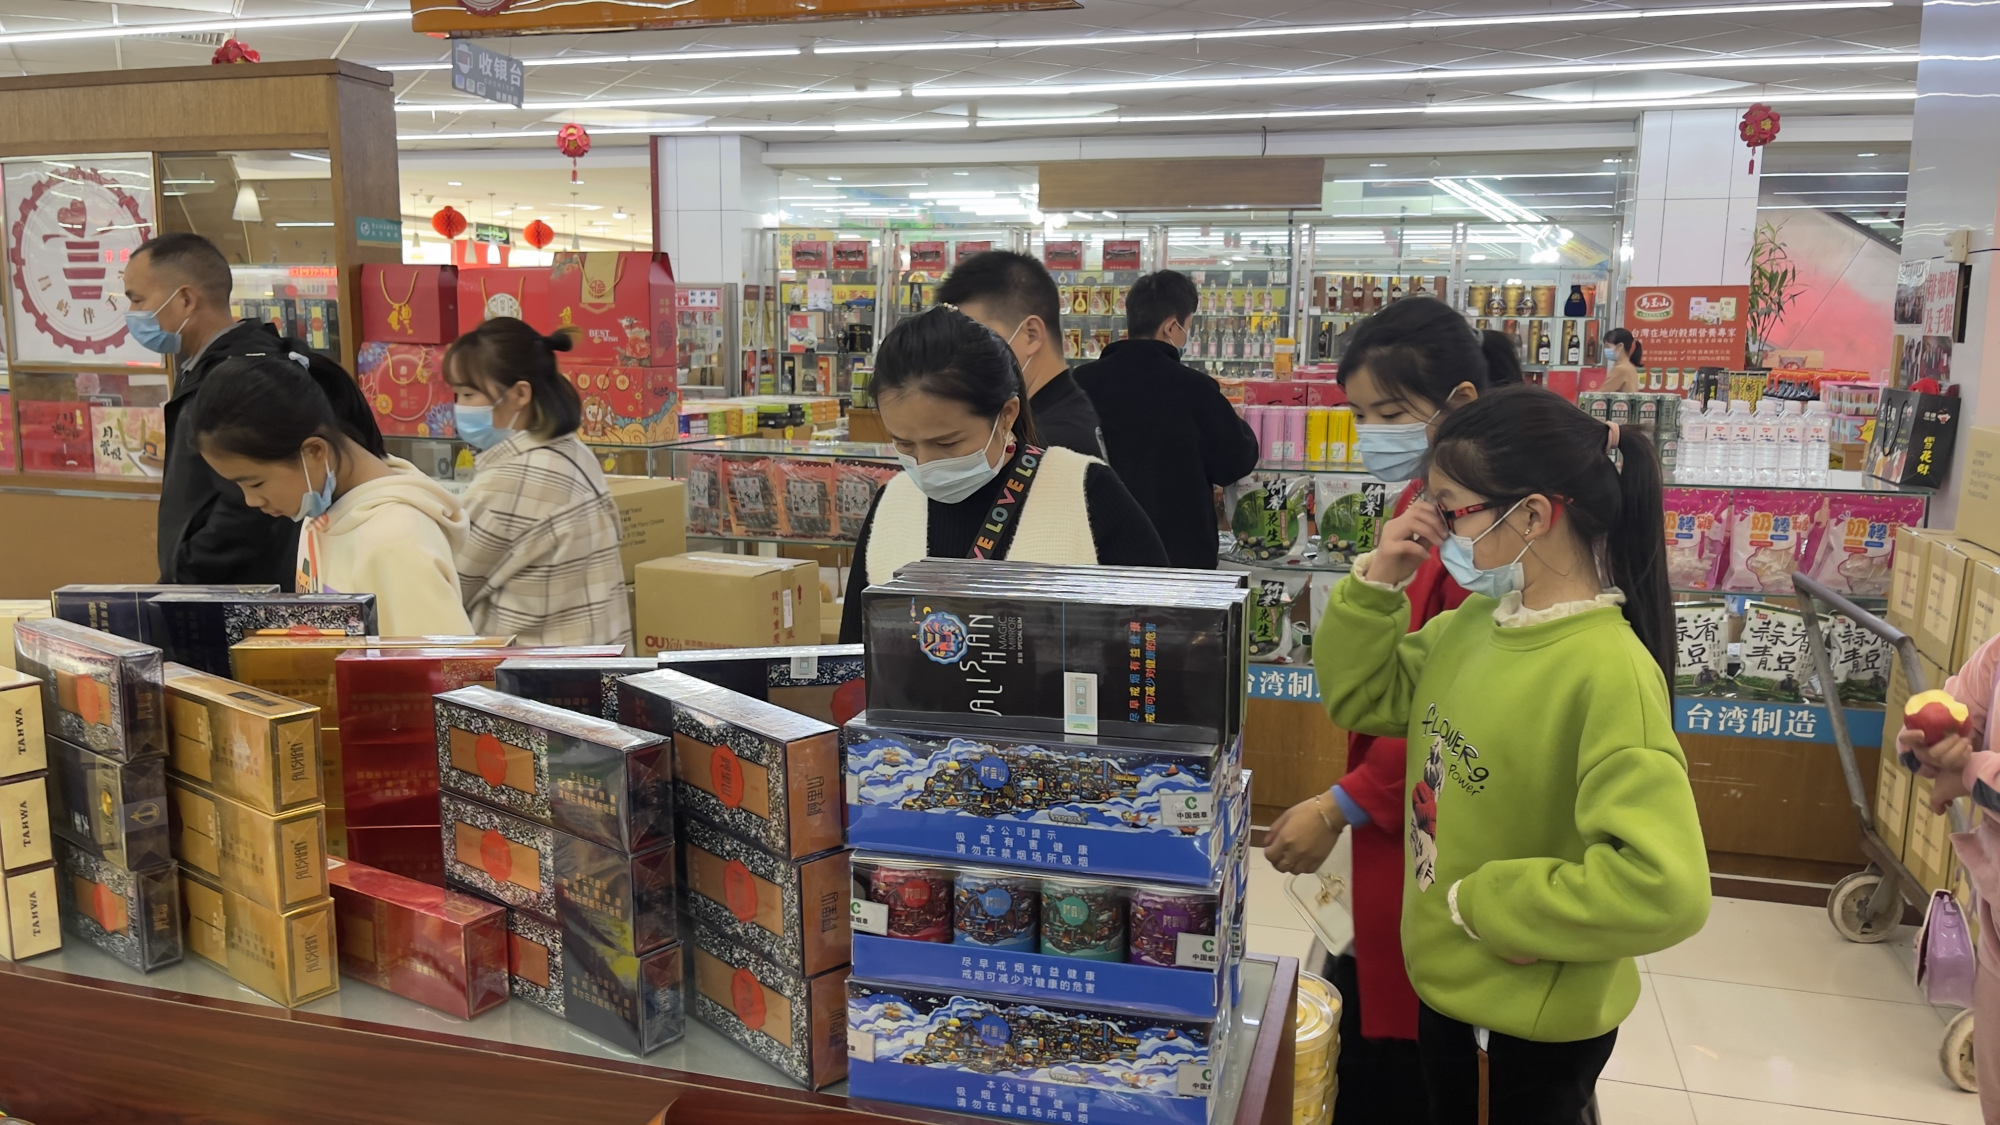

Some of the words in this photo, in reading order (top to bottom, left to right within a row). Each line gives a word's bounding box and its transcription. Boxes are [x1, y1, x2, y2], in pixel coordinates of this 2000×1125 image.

[479, 52, 521, 87] 收银台
[589, 329, 609, 338] BEST
[985, 478, 1025, 533] LOVE
[1751, 512, 1808, 534] 奶棒糖
[998, 616, 1007, 650] MAGIC
[1008, 616, 1016, 650] MIRROR
[1129, 621, 1141, 723] 尽早戒烟有益健康
[1746, 645, 1797, 673] 青豆
[1840, 648, 1880, 674] 青豆
[1145, 622, 1157, 723] 戒烟可减少对健康的危害
[1248, 671, 1320, 698] 湾制
[15, 707, 27, 756] TAHWA
[1687, 703, 1817, 739] 台湾制造
[20, 800, 32, 848] TAHWA
[1176, 811, 1208, 821] 中国烟草
[955, 832, 1088, 857] 吸烟有害健康
[986, 824, 1057, 841] 本公司提示
[956, 844, 1089, 868] 请勿在禁烟场所吸烟
[29, 891, 41, 937] TAHWA
[961, 956, 1096, 982] 尽早戒烟有益健康
[961, 969, 1096, 994] 戒烟可减少对健康的危害
[955, 1087, 1088, 1112] 吸烟有害健康
[986, 1080, 1057, 1098] 本公司提示
[956, 1099, 1089, 1124] 请勿在禁烟场所吸烟
